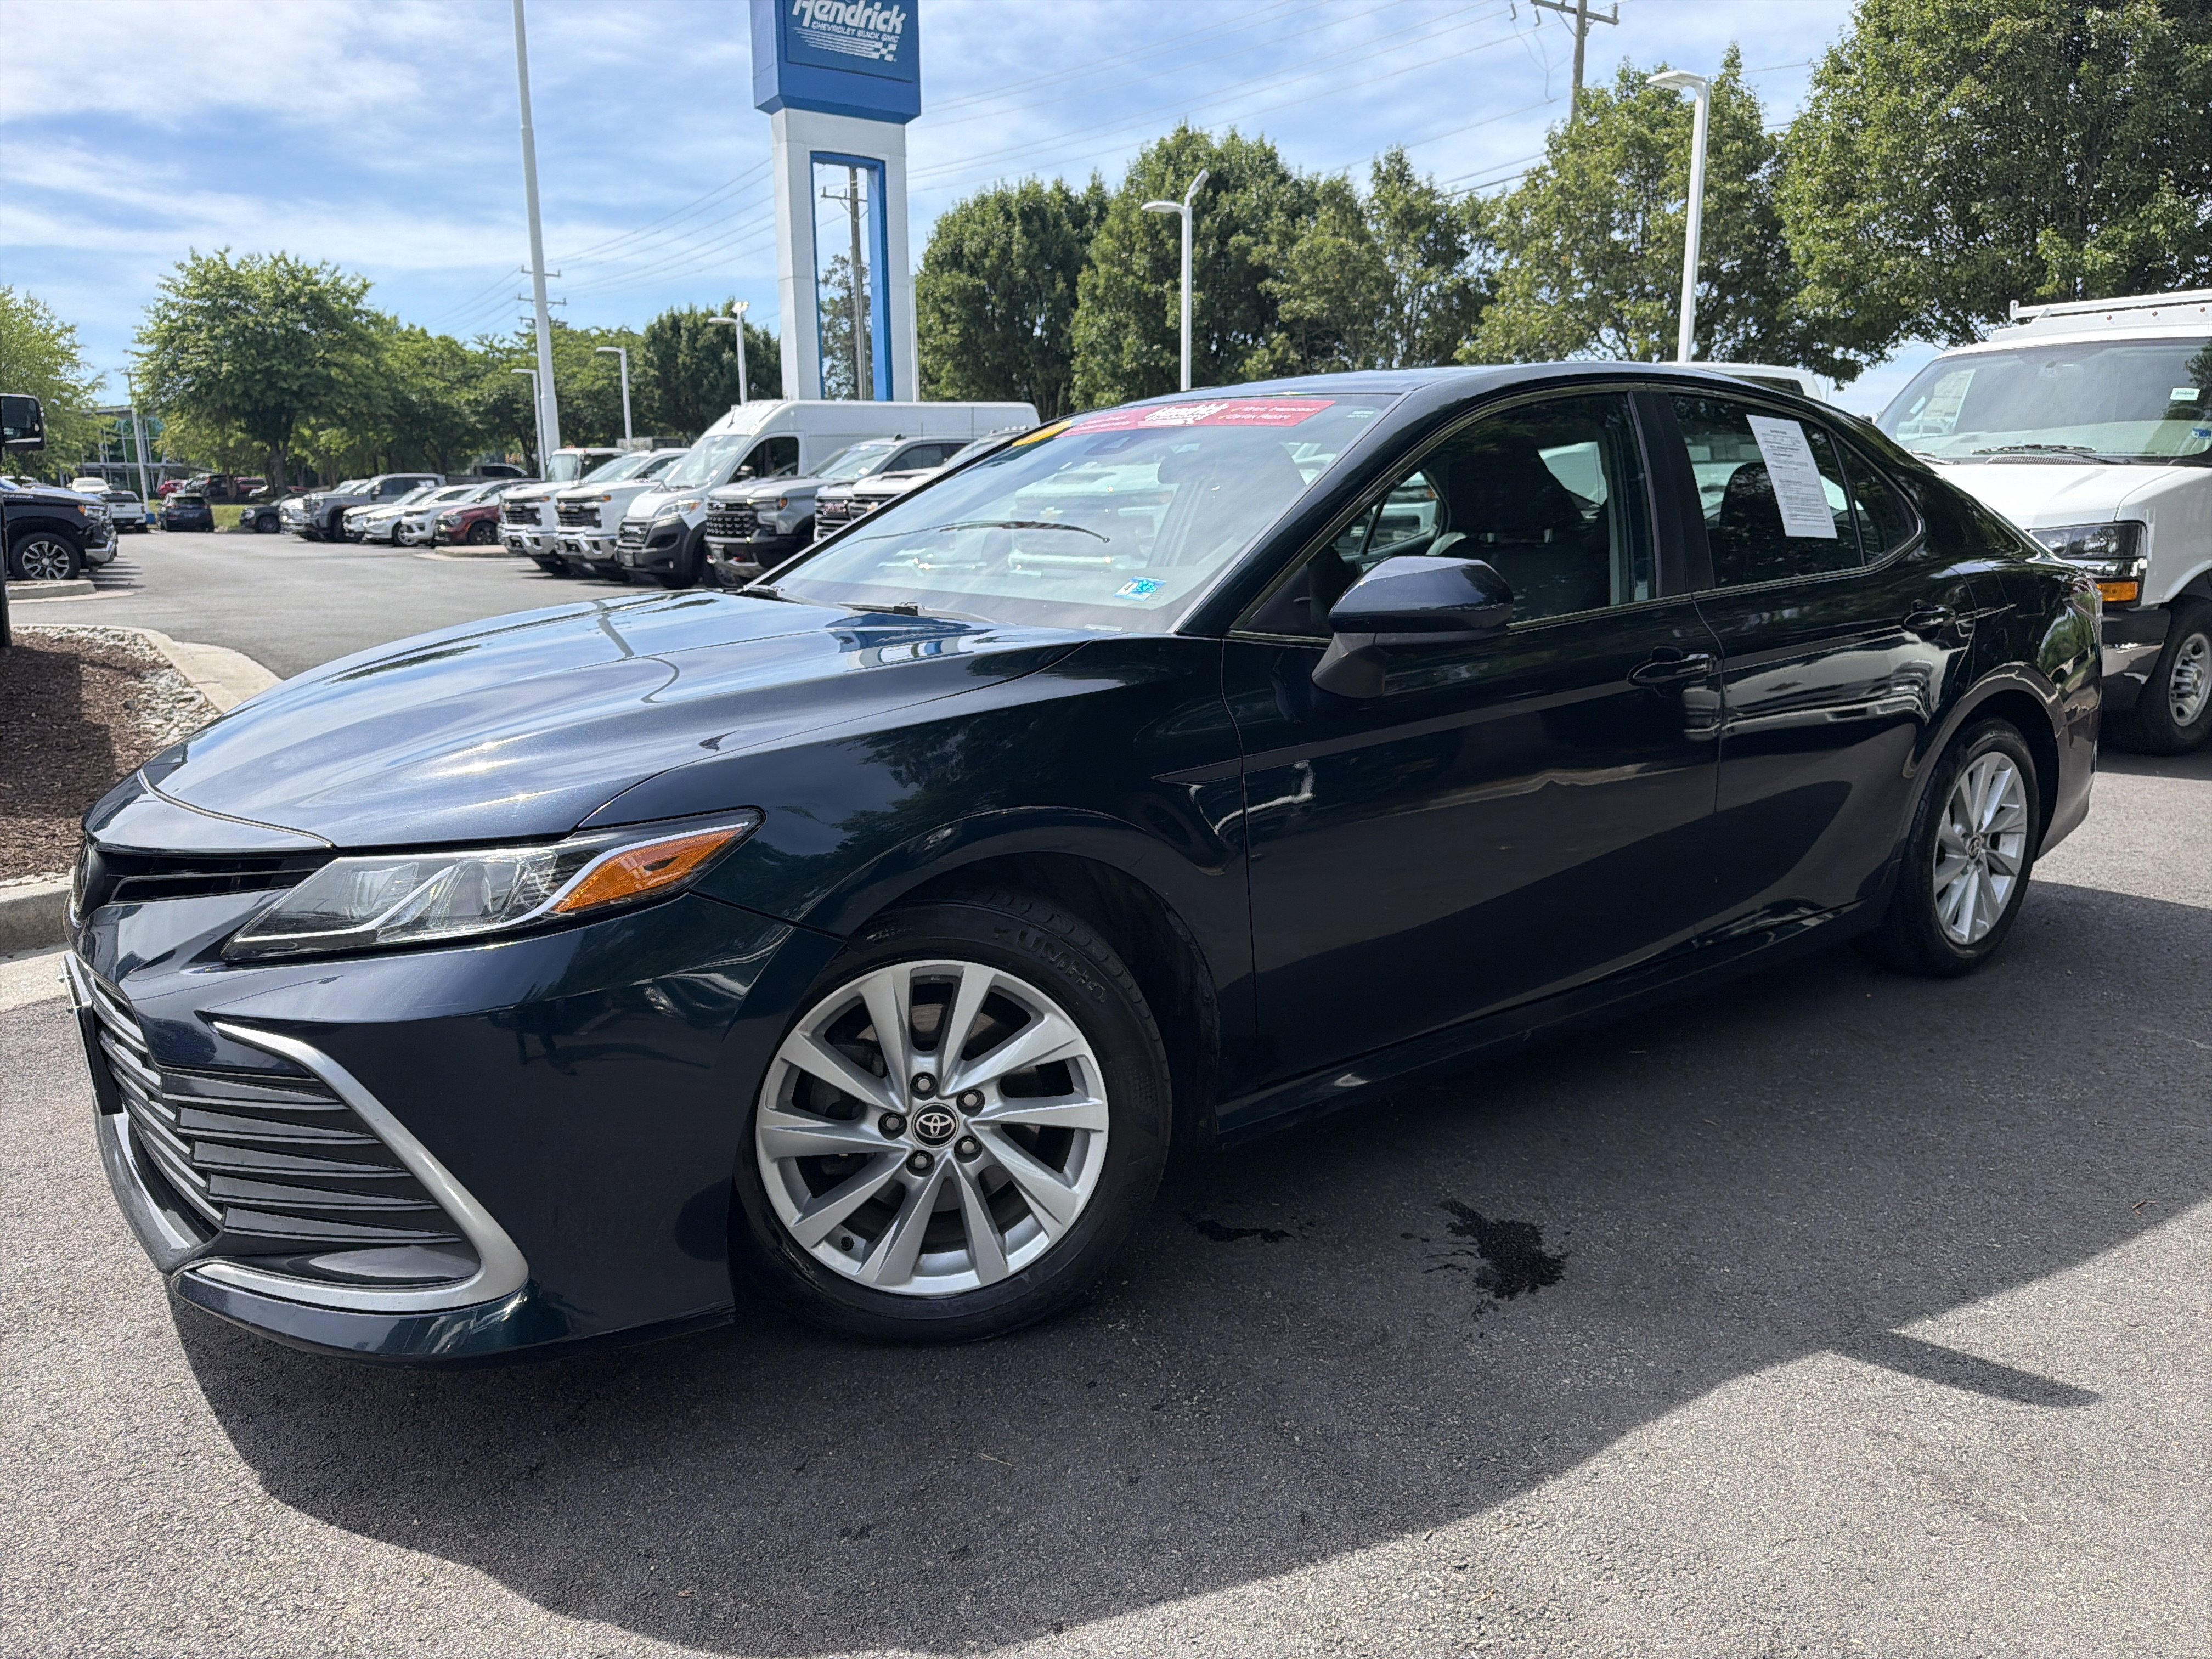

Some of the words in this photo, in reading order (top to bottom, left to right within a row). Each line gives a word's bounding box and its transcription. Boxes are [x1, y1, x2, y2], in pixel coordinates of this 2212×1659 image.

[792, 0, 906, 35] Hendrick
[811, 21, 856, 36] CHEVROLET
[856, 30, 880, 40] BUICK
[881, 34, 899, 43] GMC
